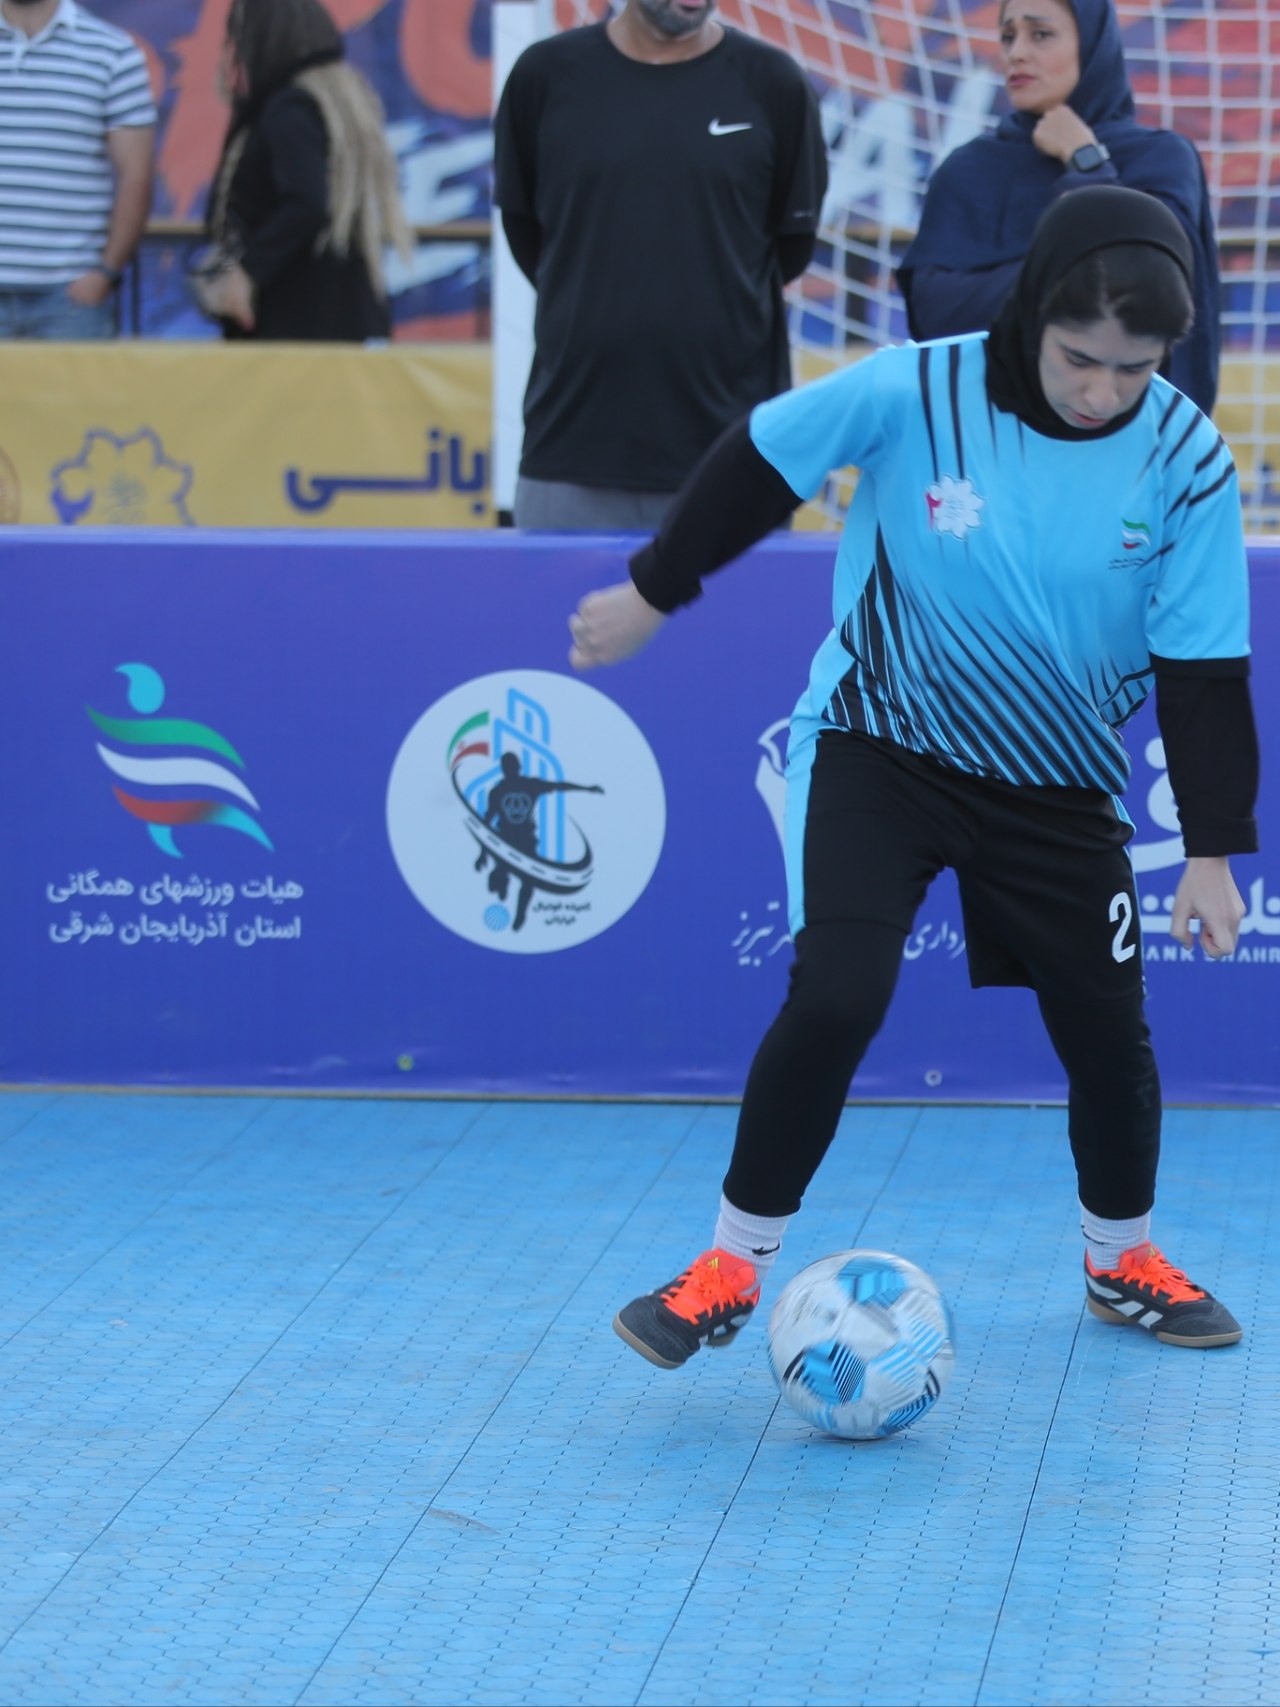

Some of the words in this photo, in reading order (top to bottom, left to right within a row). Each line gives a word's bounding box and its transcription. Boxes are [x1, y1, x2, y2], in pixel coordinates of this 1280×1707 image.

[46, 868, 135, 903] همگانی
[139, 873, 235, 906] ورزشهای
[240, 875, 304, 904] هیات
[48, 911, 115, 944] شرقی
[118, 911, 229, 945] آذربایجان
[234, 915, 302, 947] استان
[1109, 892, 1136, 963] 2
[1144, 944, 1195, 962] ANK
